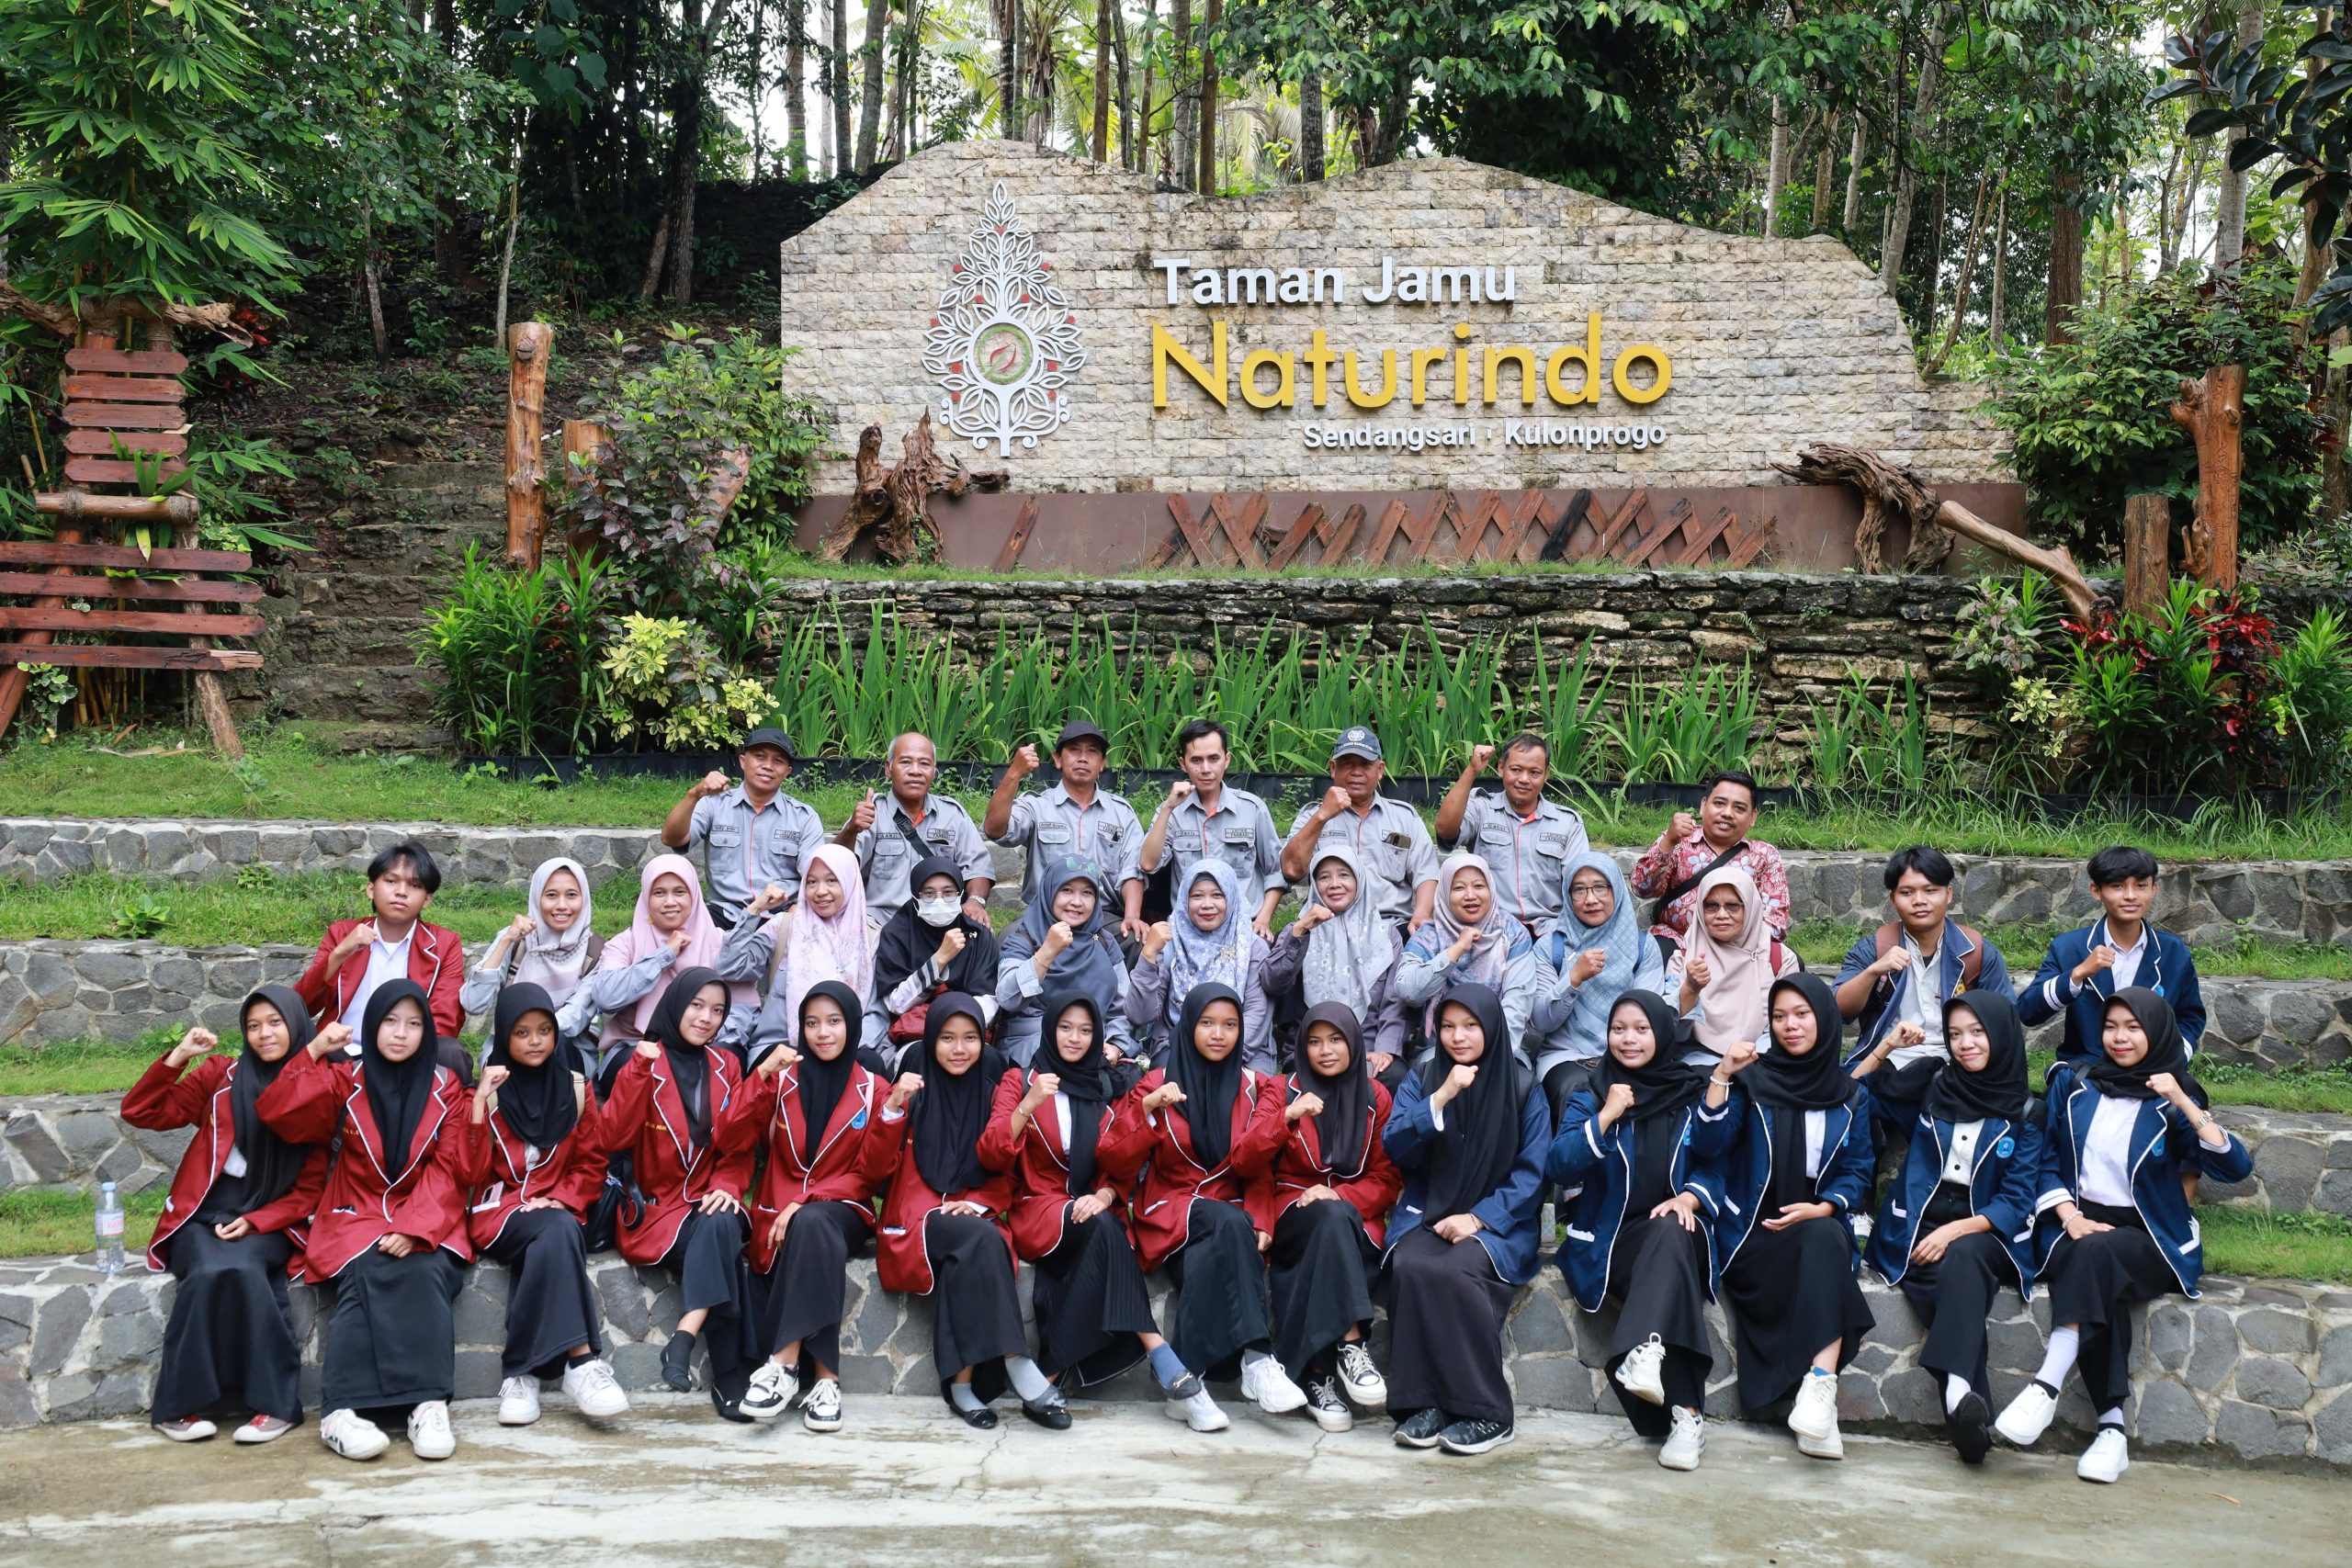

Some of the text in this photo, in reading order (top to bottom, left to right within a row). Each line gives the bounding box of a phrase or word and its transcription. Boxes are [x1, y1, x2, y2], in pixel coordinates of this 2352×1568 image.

[1153, 255, 1515, 306] Taman Jamu
[1152, 311, 1673, 409] Naturindo
[1303, 419, 1667, 452] Sendangsari Kulonprogo
